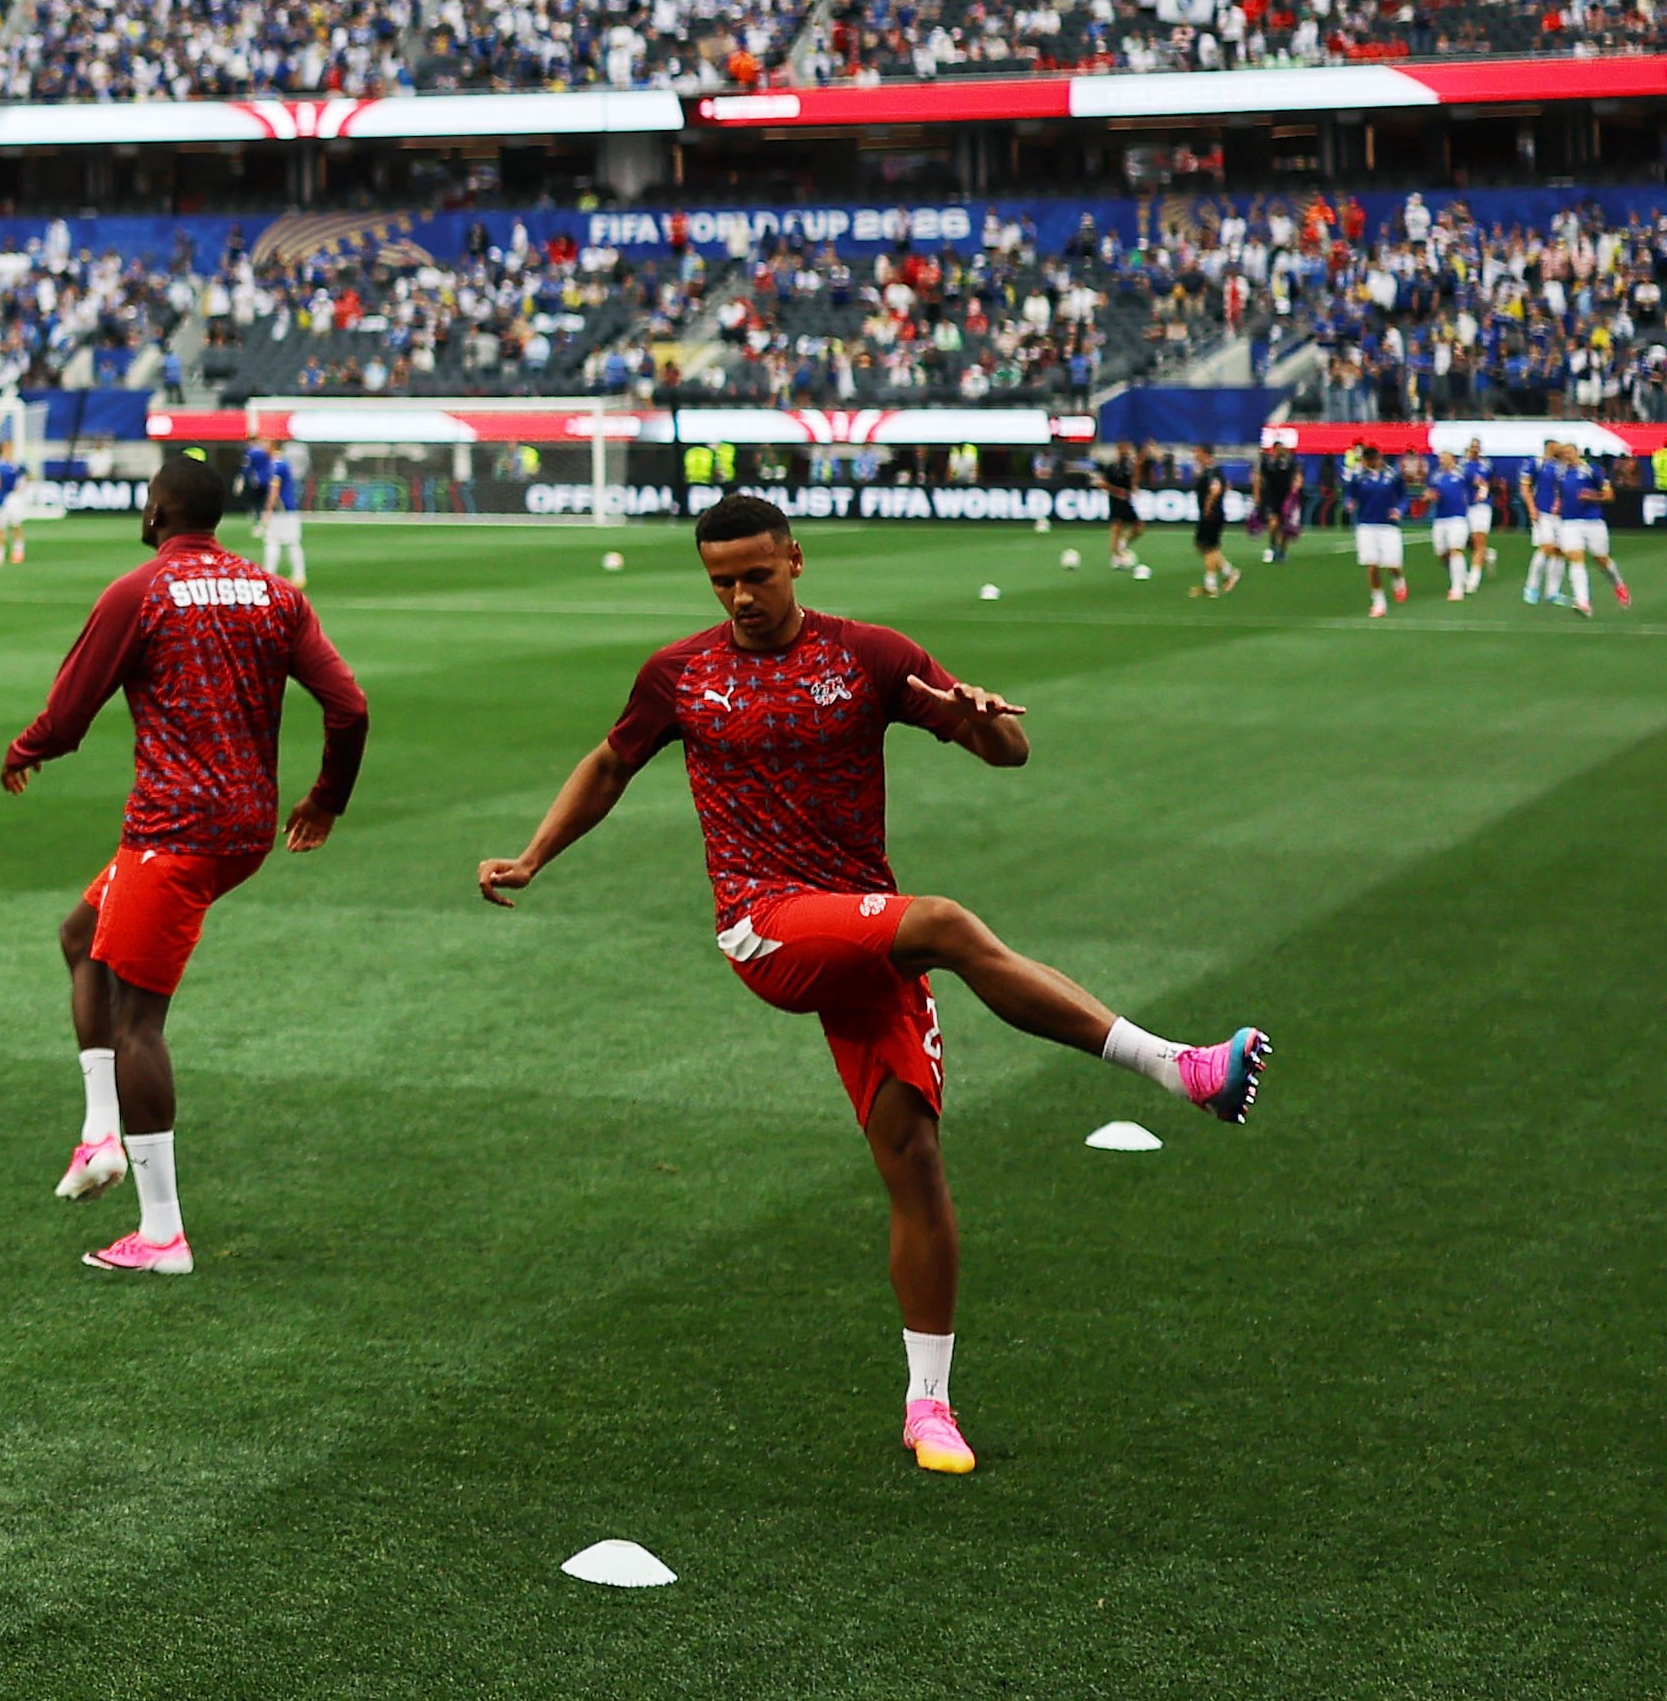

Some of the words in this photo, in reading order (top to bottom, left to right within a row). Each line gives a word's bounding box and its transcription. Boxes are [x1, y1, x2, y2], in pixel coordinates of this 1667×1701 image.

[589, 212, 660, 245] FIFA
[859, 486, 931, 518] FIFA
[931, 487, 1053, 519] WORLD
[167, 577, 271, 608] SUISSE
